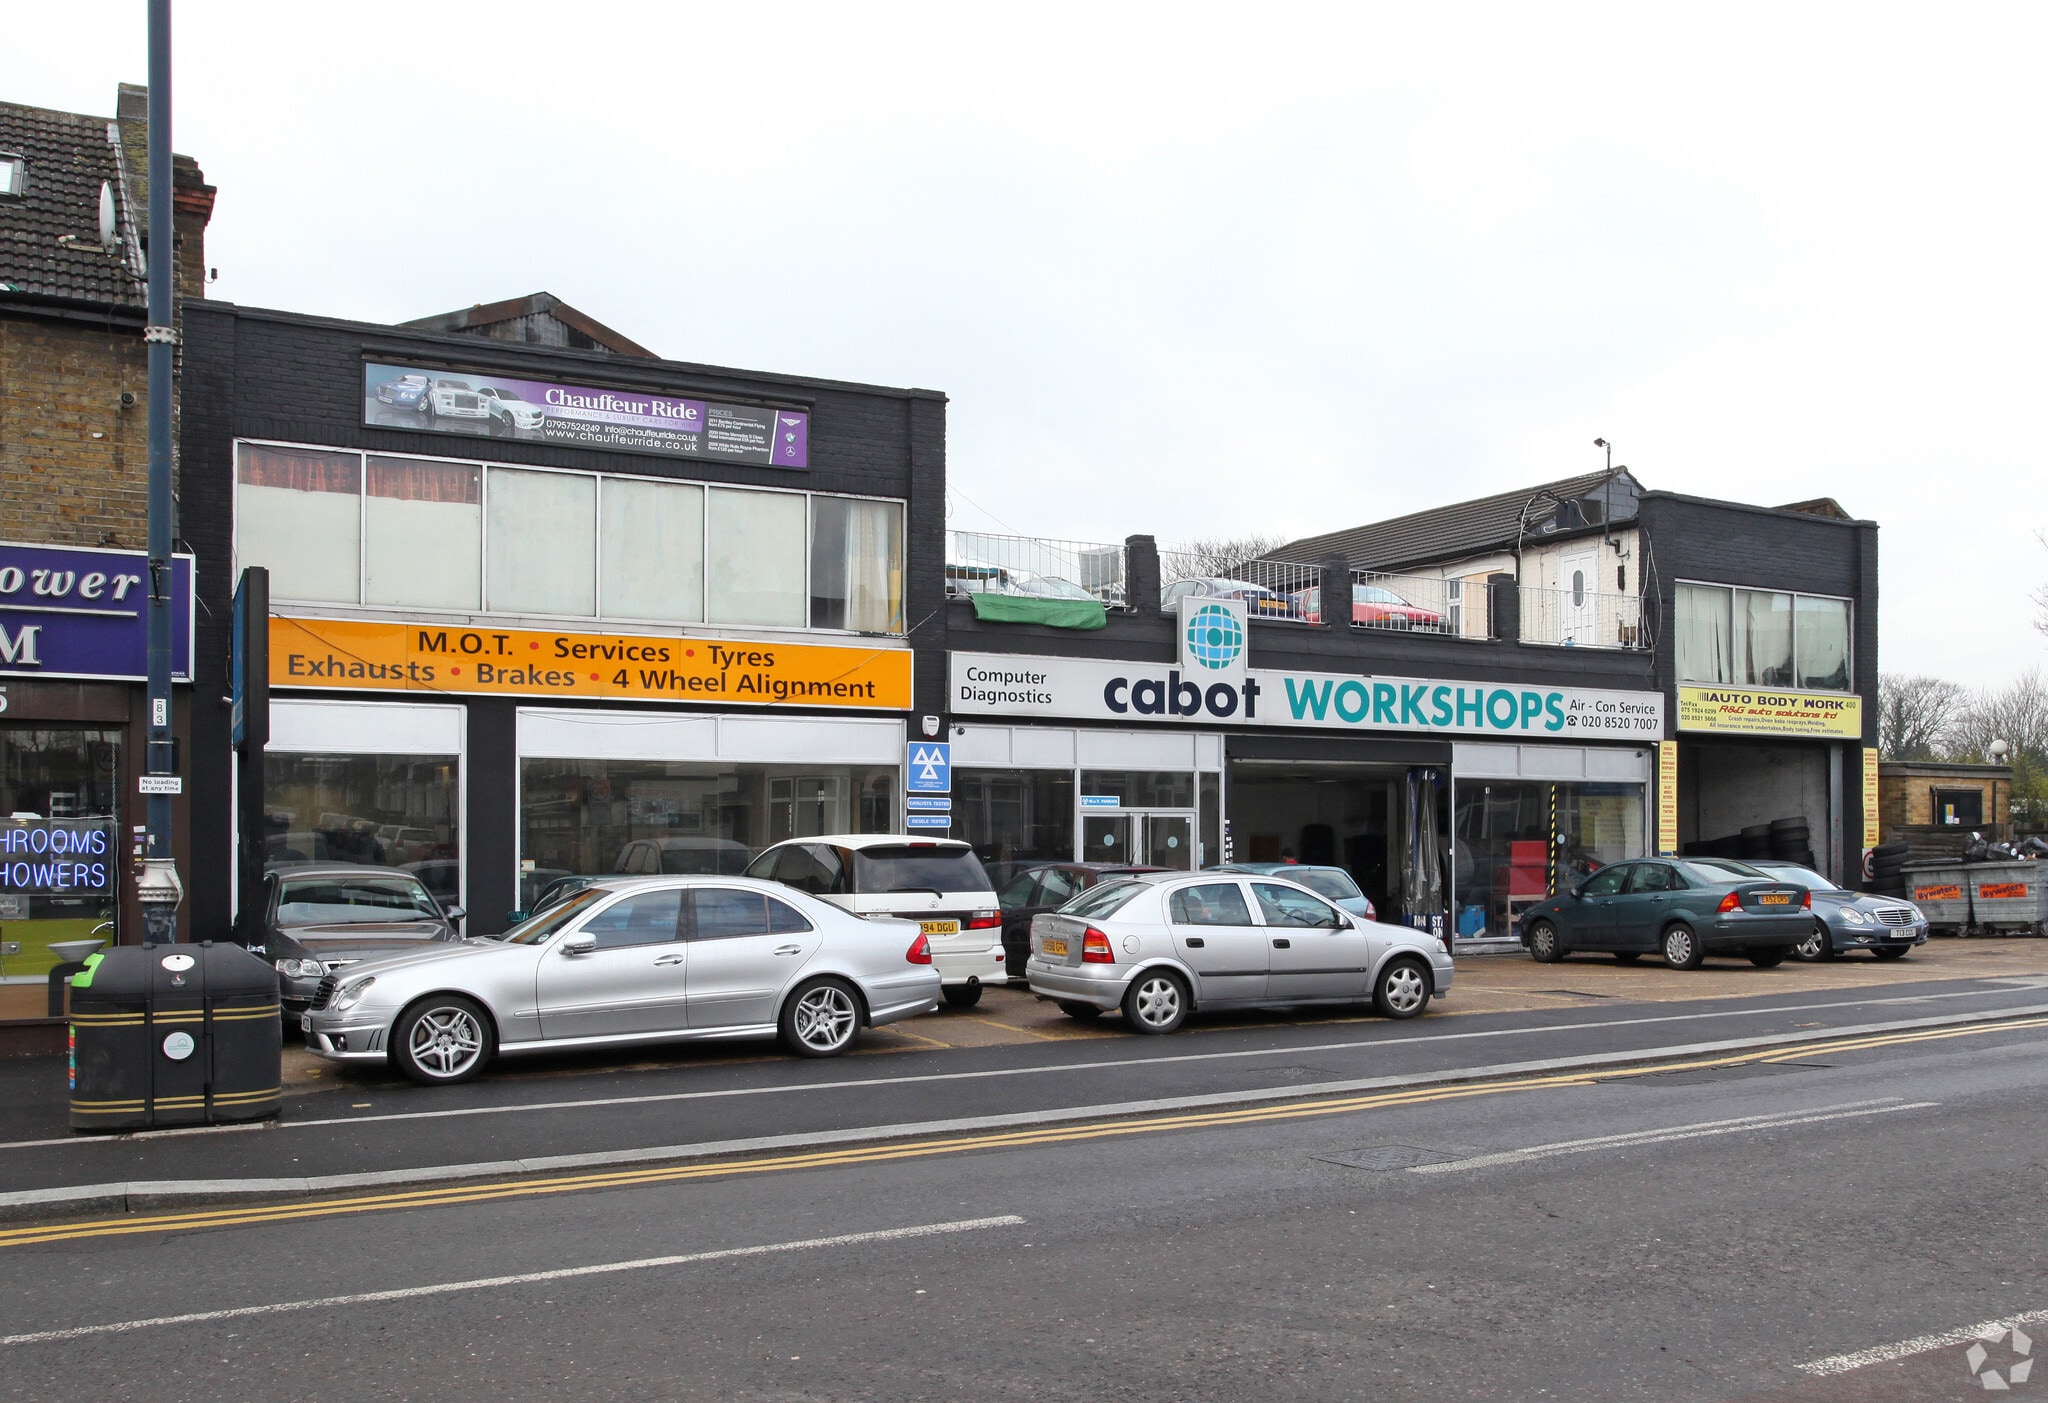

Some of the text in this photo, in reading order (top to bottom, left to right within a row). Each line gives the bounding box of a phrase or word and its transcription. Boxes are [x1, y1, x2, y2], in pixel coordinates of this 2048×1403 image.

[545, 388, 697, 420] Chauffeur Ride
[546, 407, 603, 419] PERFORMANCE
[613, 415, 640, 423] LUXURY
[642, 417, 662, 425] CARS
[546, 420, 600, 432] 07957524249
[546, 429, 697, 451] www.chauffeurride.co.uk
[418, 632, 775, 670] M.O.T. Services Tyres
[288, 654, 876, 701] Exhausts Brakes 4 Wheel Alignment
[967, 666, 1047, 688] Computer
[961, 683, 1052, 707] Diagnostics
[1104, 668, 1260, 719] cabot
[1707, 693, 1845, 710] AUTO BODY WORK
[1284, 676, 1565, 732] WORKSHOPS
[1570, 699, 1586, 711] Air
[1595, 701, 1616, 713] Con
[1619, 701, 1655, 715] Service
[1718, 705, 1837, 719] R&G auto solutions ltd
[1581, 715, 1658, 730] 020 8520 7007
[1917, 885, 1958, 900] Bywaters
[1983, 883, 2024, 898] Bywaters
[937, 923, 954, 932] DGU
